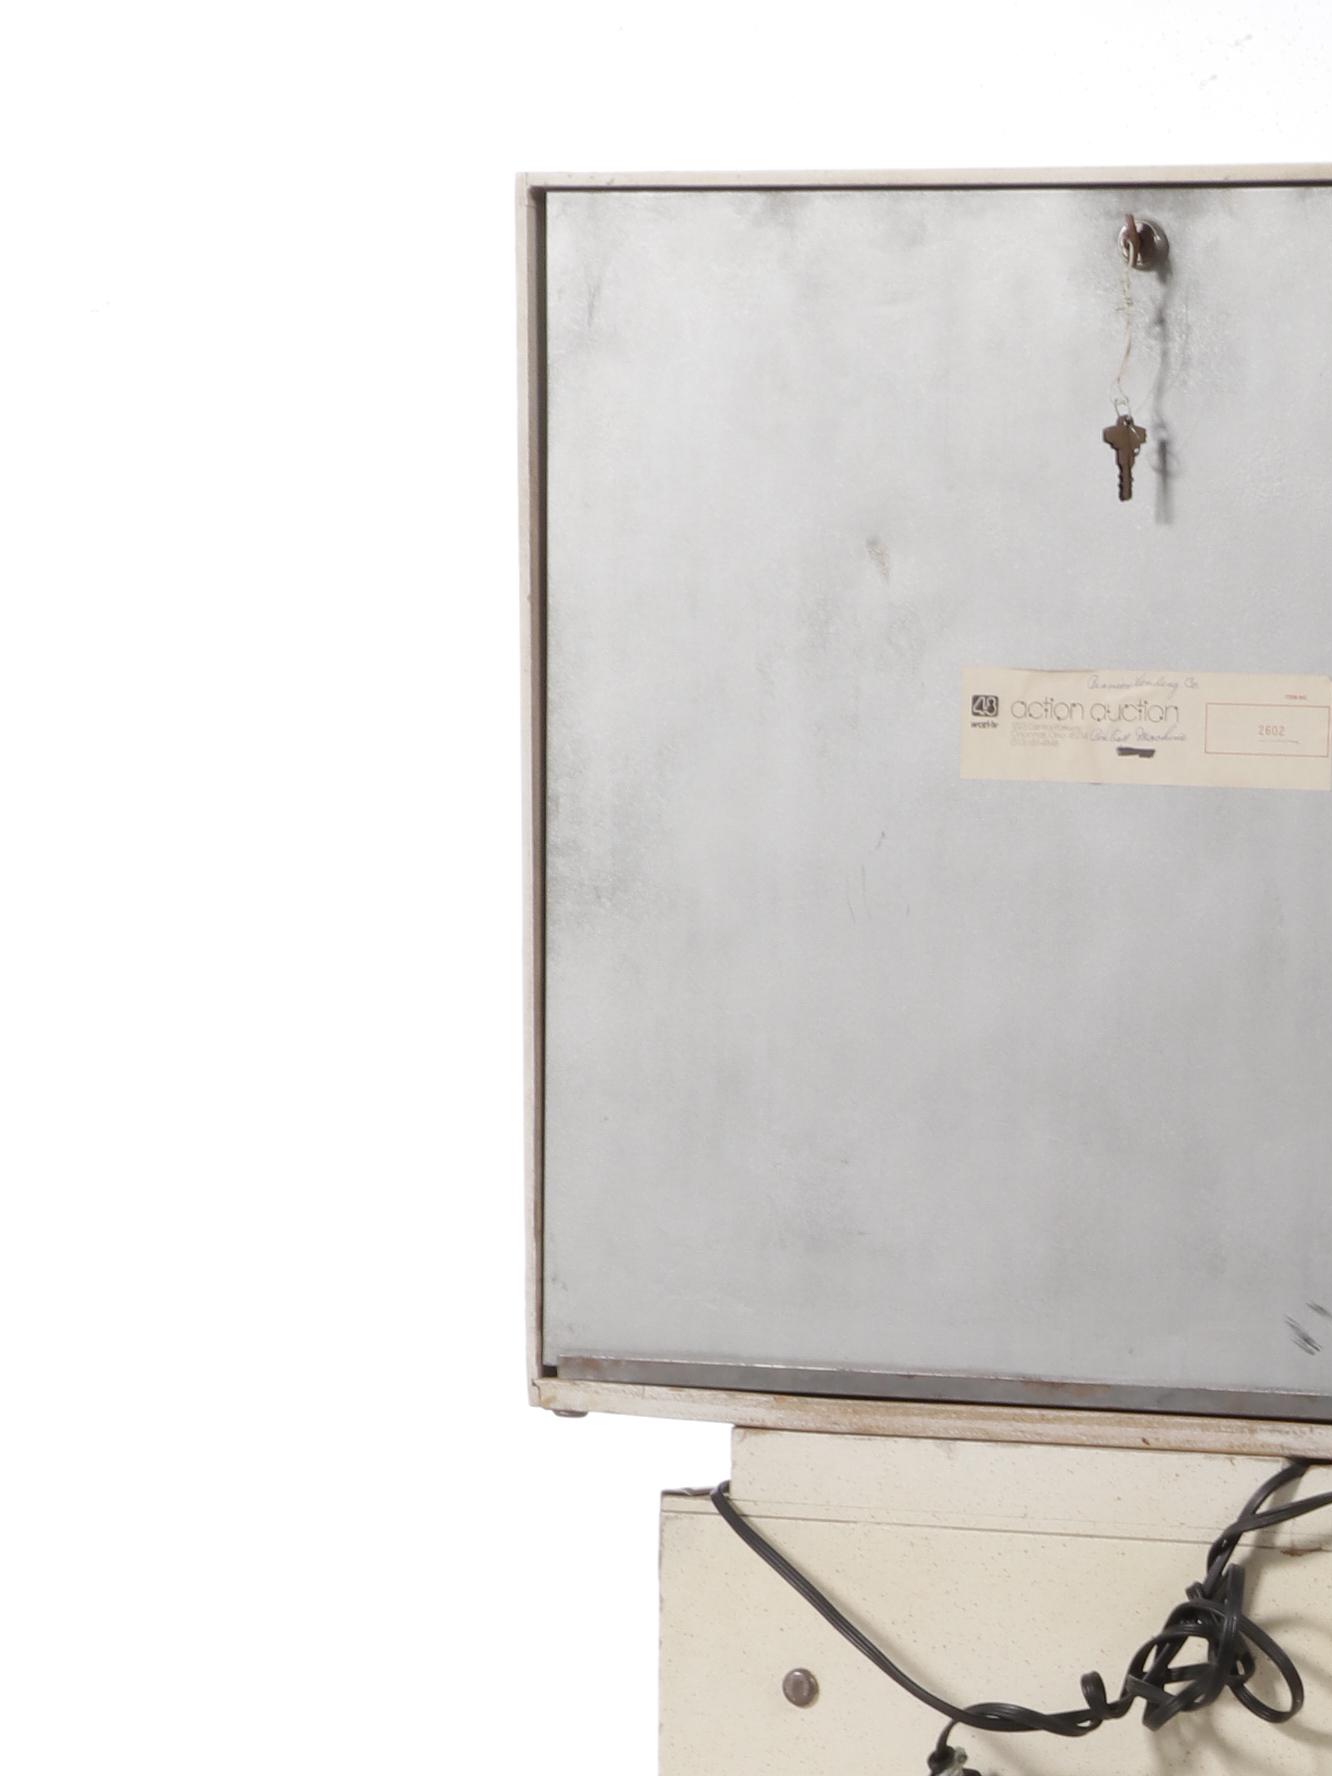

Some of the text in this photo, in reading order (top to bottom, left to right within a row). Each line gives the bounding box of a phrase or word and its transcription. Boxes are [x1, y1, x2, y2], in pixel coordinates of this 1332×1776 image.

[1011, 696, 1179, 723] action auction
[1257, 724, 1286, 737] 2602
